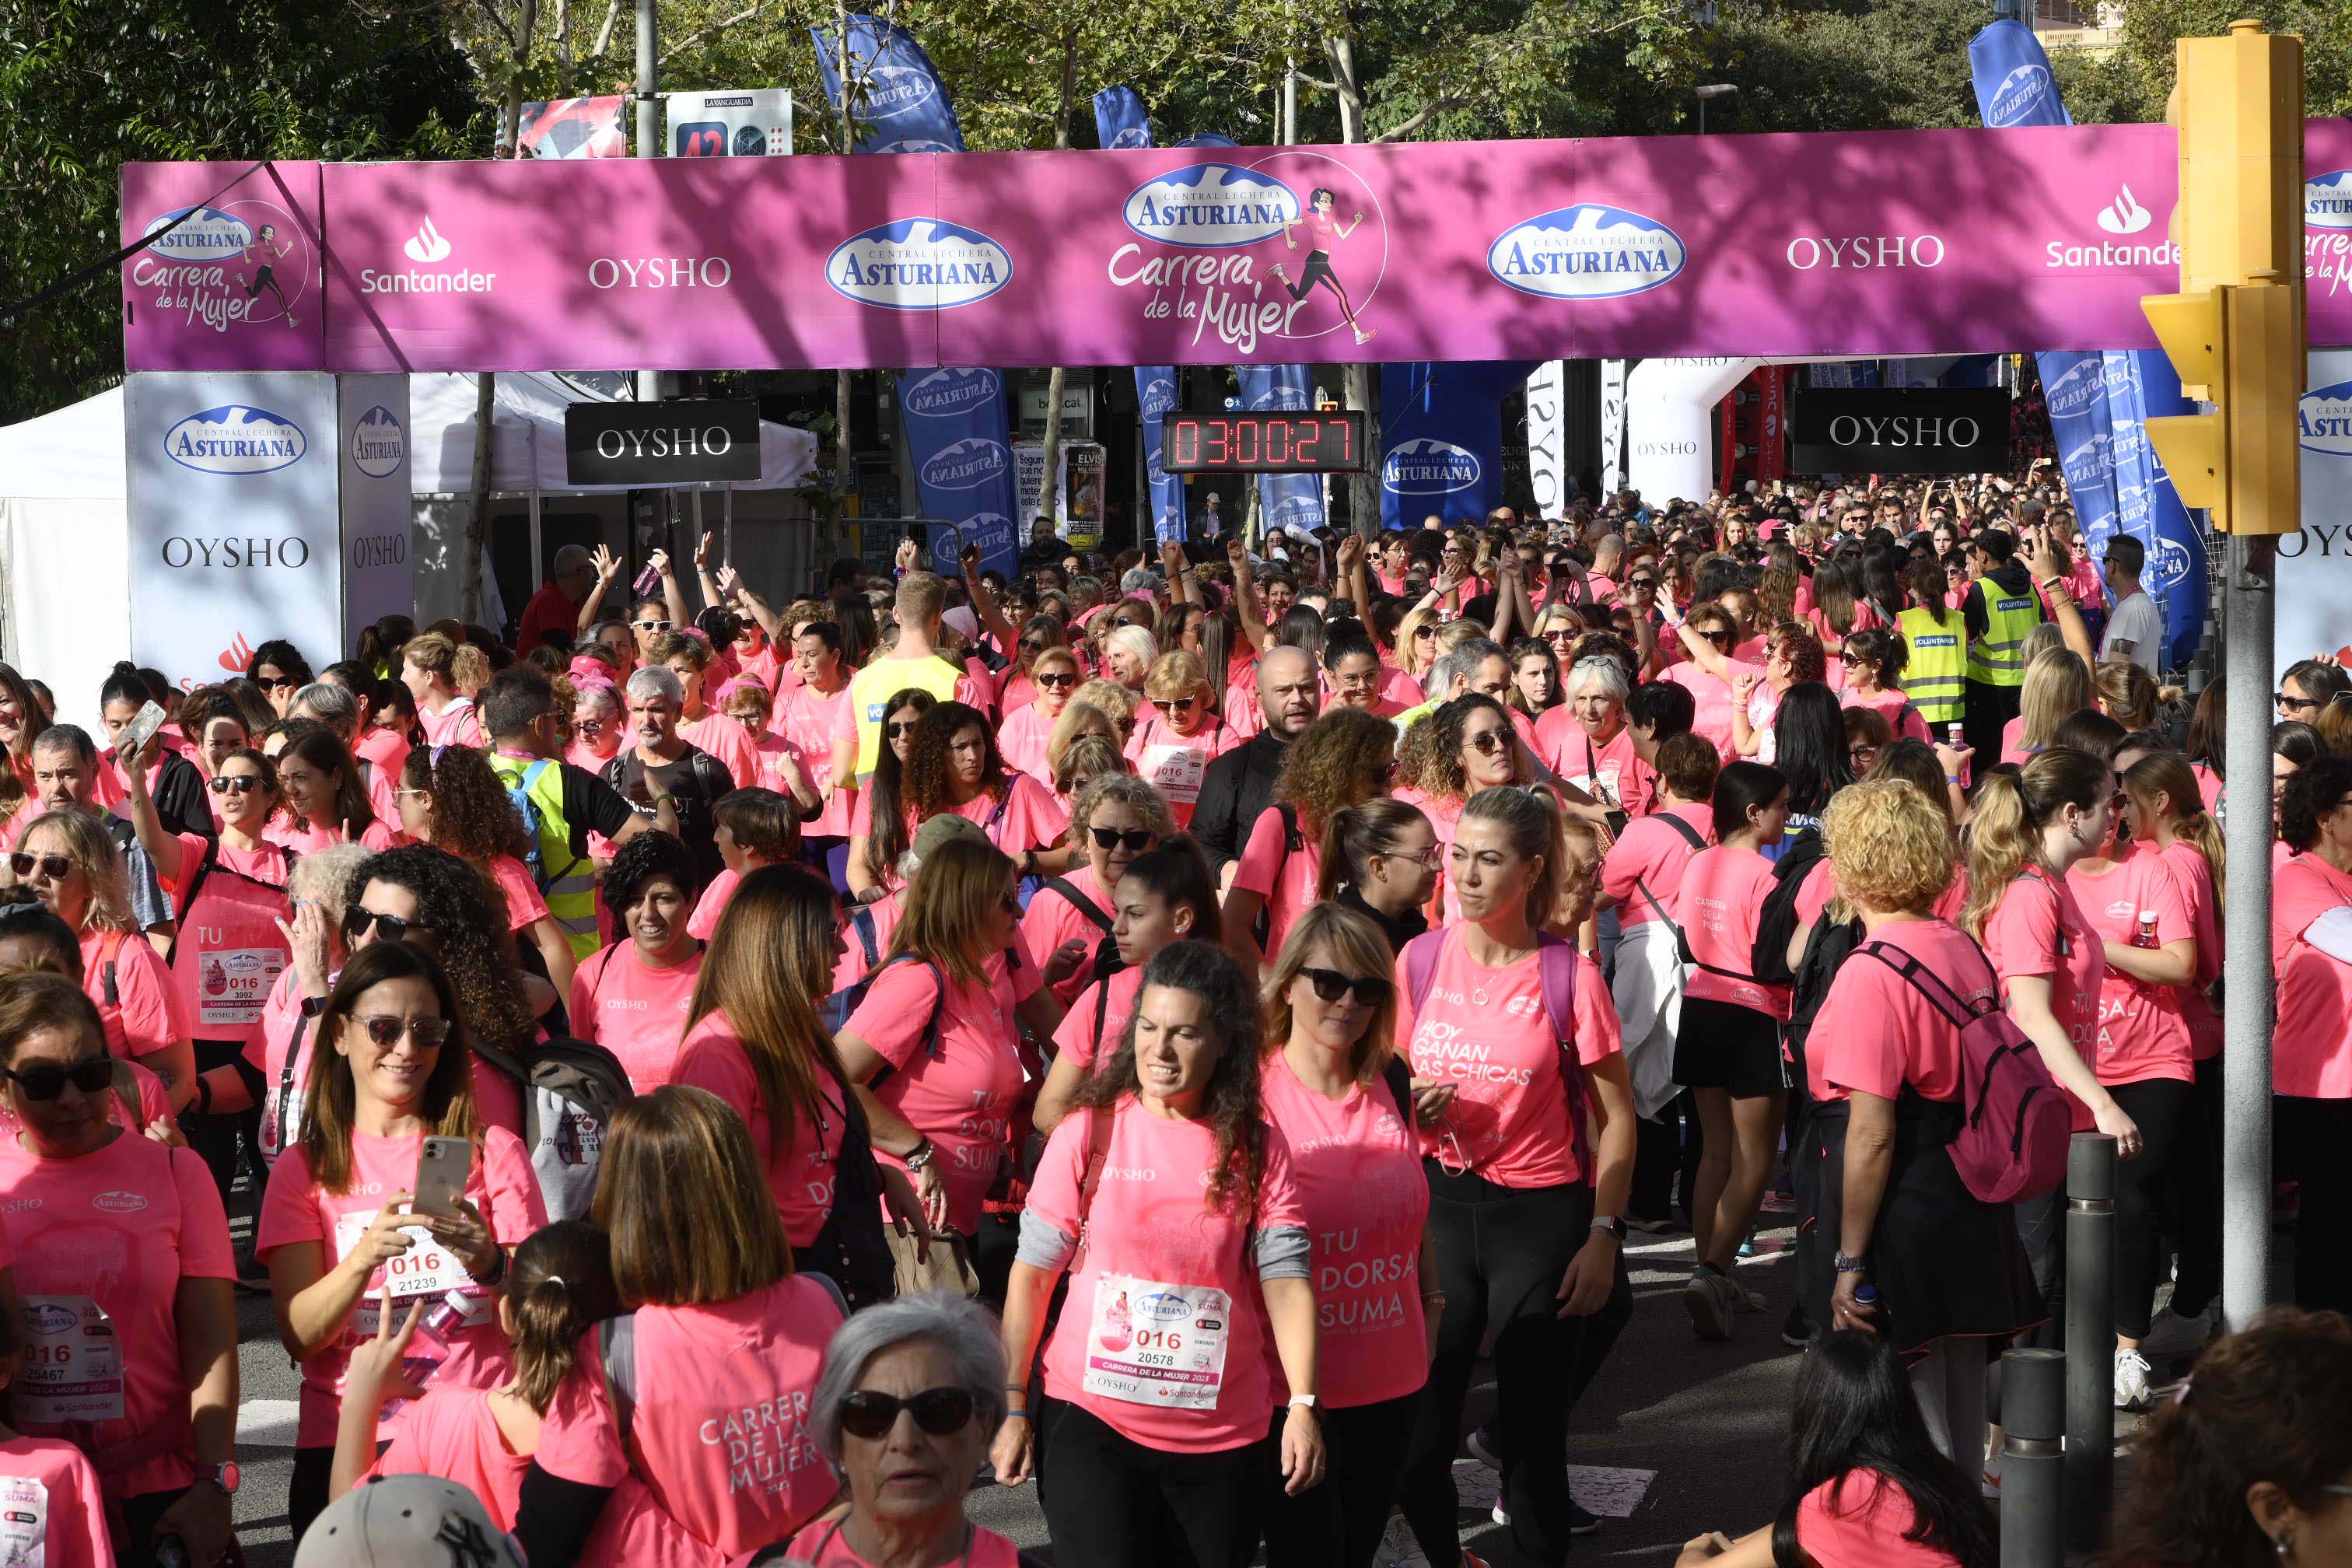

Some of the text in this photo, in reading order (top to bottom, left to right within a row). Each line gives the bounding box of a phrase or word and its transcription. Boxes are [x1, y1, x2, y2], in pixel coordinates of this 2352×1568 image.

[1164, 191, 1281, 201] CENTRAL LECHERA
[1136, 194, 1286, 227] ASTURIANA
[1533, 236, 1664, 247] CENTRAL LECHERA
[868, 248, 927, 258] CENTRAL
[1503, 241, 1671, 276] ASTURIANA
[1787, 235, 1944, 270] OYSHO
[2046, 240, 2182, 267] Santande
[133, 258, 224, 287] Carrera
[589, 257, 731, 288] OYSHO
[841, 253, 997, 286] ASTURIANA
[1108, 243, 1254, 287] Carrera
[361, 268, 496, 293] Santander
[156, 284, 259, 332] de la Mujer
[1144, 279, 1308, 354] de la Mujer
[1829, 415, 1979, 447] OYSHO
[176, 430, 296, 457] ASTURIANA
[356, 432, 401, 460] ASTURIANA
[597, 426, 731, 459] OYSHO
[1177, 421, 1349, 463] 03:00:27
[1078, 454, 1101, 464] ELVIS
[1384, 460, 1472, 482] ASTURIANA
[1020, 478, 1045, 487] quiere
[162, 537, 309, 568] OYSHO
[353, 534, 404, 569] OYSHO
[1915, 636, 1955, 646] VOLUNTARIS
[1162, 768, 1182, 776] 016
[1695, 897, 1726, 911] CARRERA
[198, 926, 222, 944] TU
[229, 978, 258, 989] 016
[607, 999, 647, 1010] OYSHO
[2099, 999, 2137, 1019] SAL
[1418, 1020, 1464, 1040] HOY
[1413, 1038, 1490, 1062] GANAN
[1412, 1056, 1532, 1086] LAS CHICAS
[972, 1090, 1000, 1111] TU
[1300, 1134, 1346, 1153] OYSHO
[1102, 1168, 1155, 1182] OYSHO
[1320, 1227, 1358, 1255] TU
[391, 1253, 440, 1275] 016
[1322, 1250, 1415, 1291] DORSA
[399, 1277, 436, 1292] 21239
[1142, 1301, 1187, 1315] ASTURIANA
[1198, 1304, 1222, 1312] SUMA
[1320, 1292, 1404, 1327] SUMA
[1136, 1329, 1181, 1349] 016
[26, 1343, 71, 1363] 016
[1138, 1352, 1174, 1366] 20578
[27, 1369, 65, 1381] 25467
[1102, 1362, 1137, 1374] CARRERA
[1164, 1372, 1190, 1381] MUJER
[56, 1385, 86, 1394] MUJER
[1097, 1377, 1137, 1393] OYSHO
[1170, 1388, 1209, 1400] Santander
[66, 1401, 113, 1412] Santander
[700, 1391, 808, 1445] CARRER
[730, 1419, 810, 1465] DE LA
[730, 1442, 818, 1493] MUJER
[4, 1494, 37, 1503] SUMA
